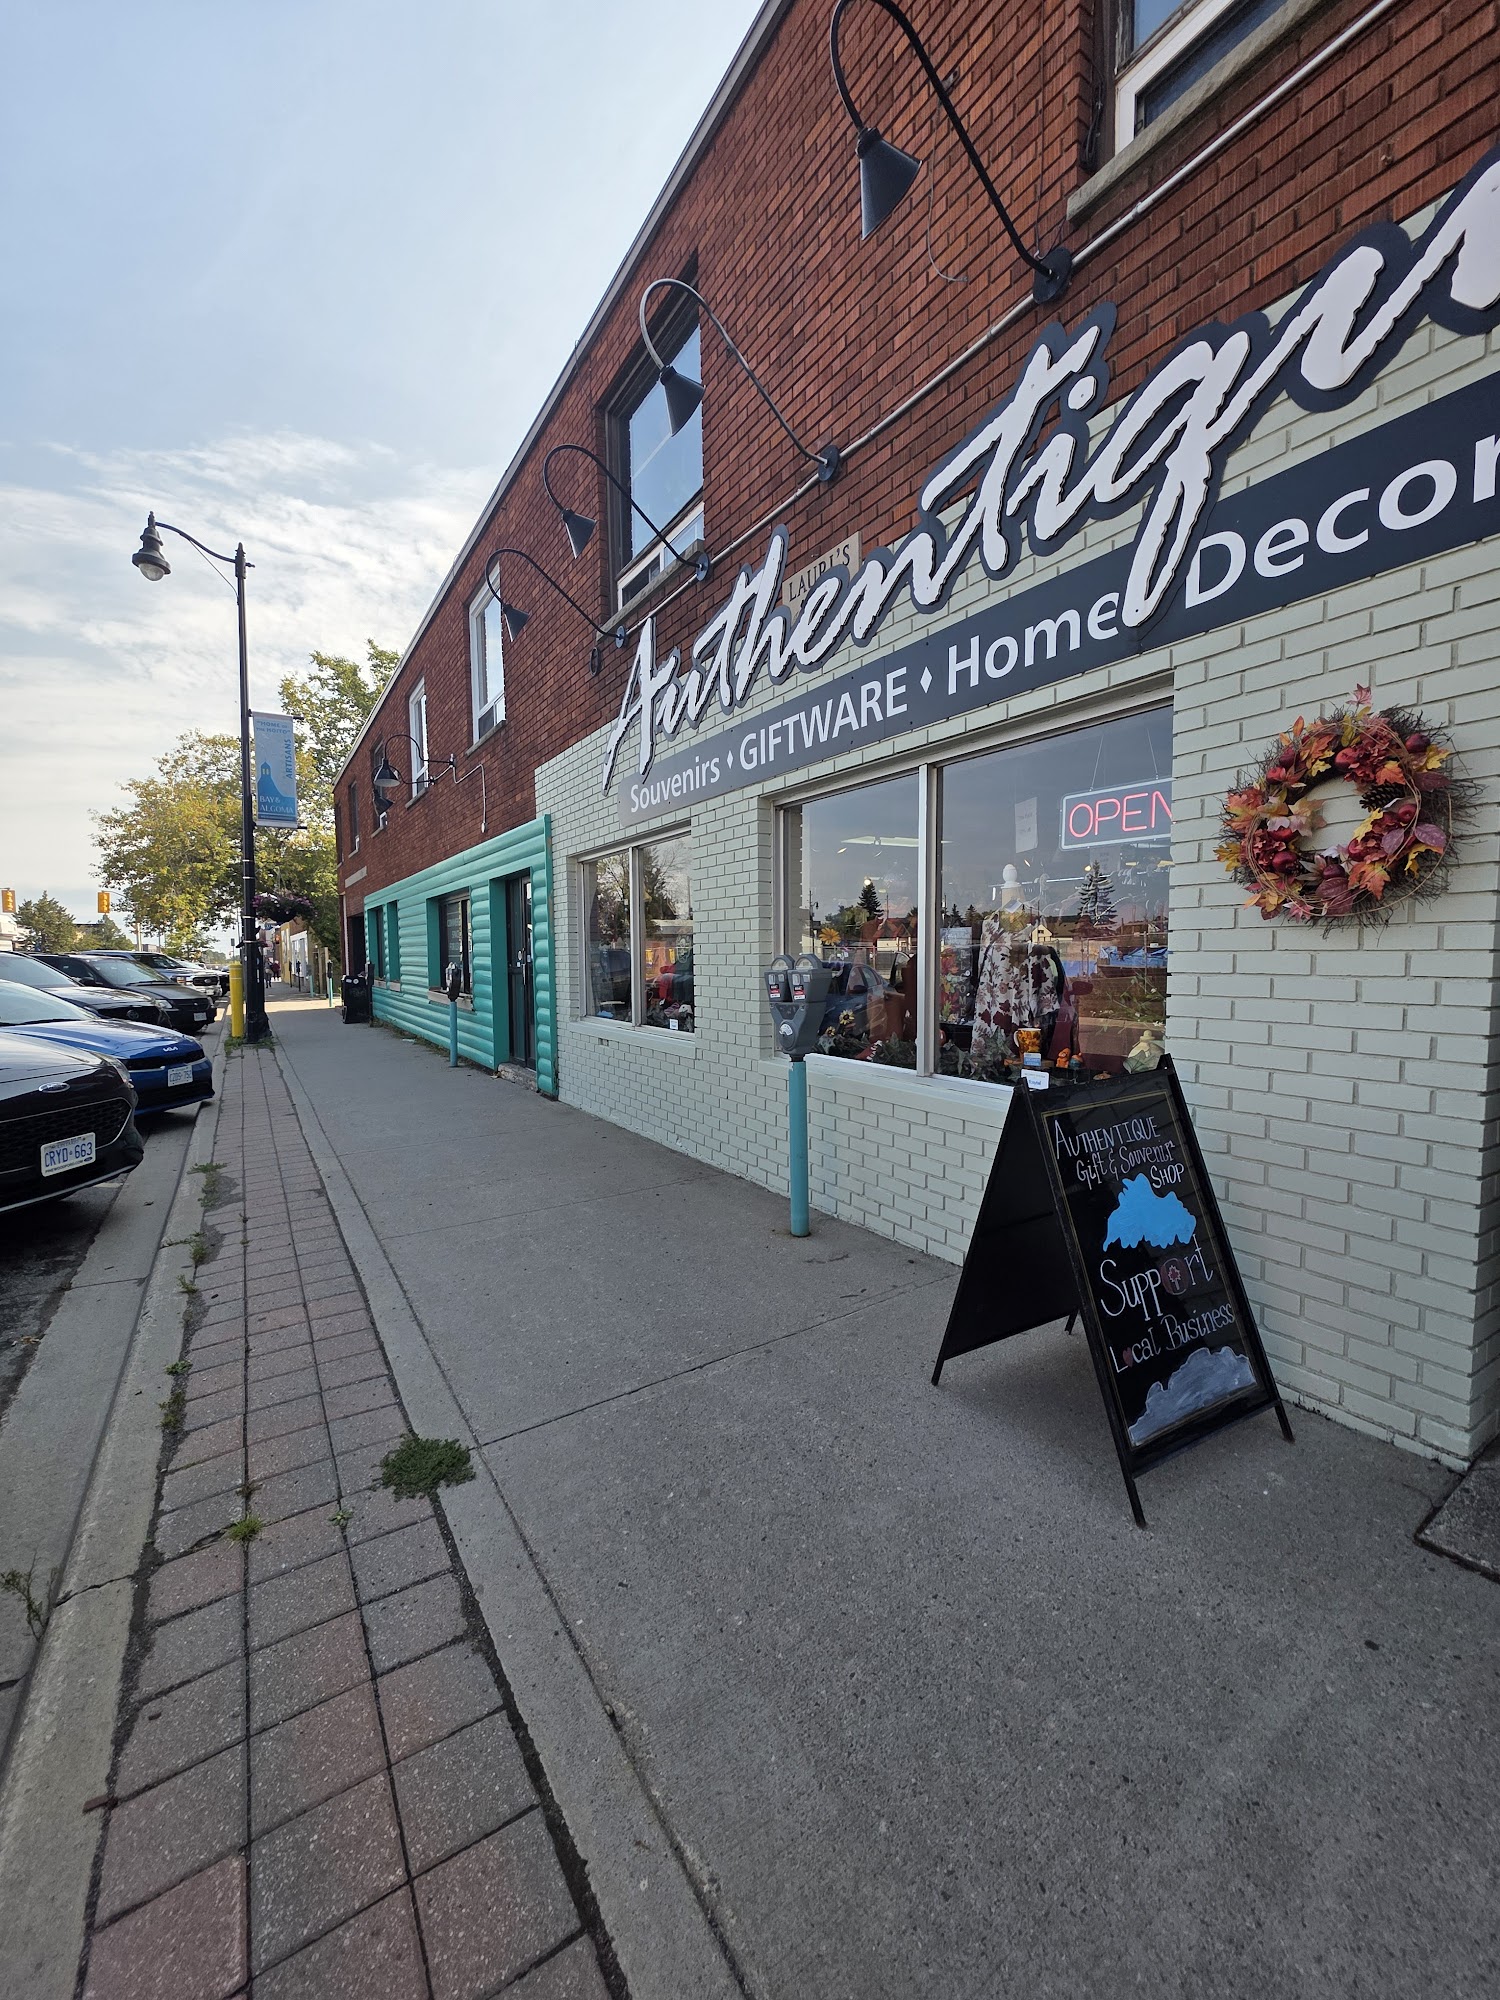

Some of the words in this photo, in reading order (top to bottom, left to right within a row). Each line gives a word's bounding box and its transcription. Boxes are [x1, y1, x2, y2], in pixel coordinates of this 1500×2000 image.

[630, 756, 721, 813] Souvenirs
[739, 666, 908, 771] GIFTWARE
[948, 591, 1120, 695] Home
[284, 738, 293, 780] ARTISANS
[259, 803, 294, 815] ALGOMA
[44, 1147, 69, 1168] CRYD
[74, 1141, 93, 1159] 663
[1054, 1116, 1161, 1160] AUTHENTIQUE
[1076, 1151, 1108, 1190] Gift
[1119, 1140, 1176, 1174] Souvenir
[1150, 1162, 1185, 1189] SHOP
[1100, 1233, 1213, 1322] Support
[1160, 1302, 1236, 1350] Business
